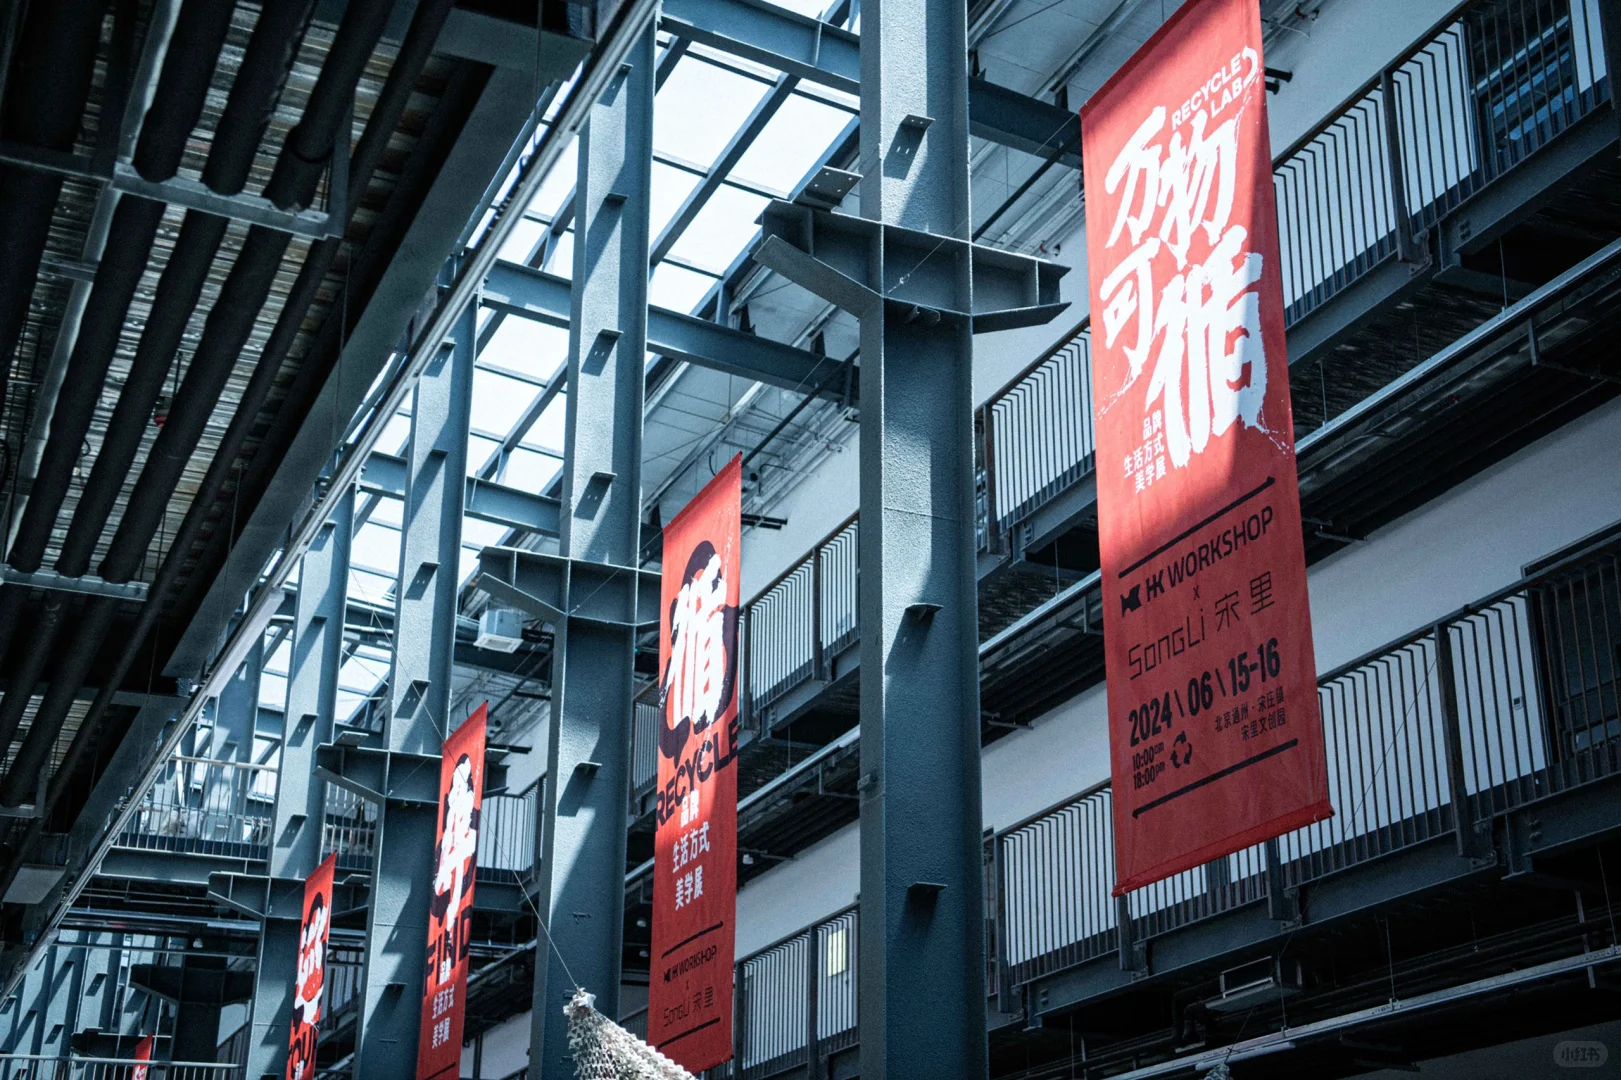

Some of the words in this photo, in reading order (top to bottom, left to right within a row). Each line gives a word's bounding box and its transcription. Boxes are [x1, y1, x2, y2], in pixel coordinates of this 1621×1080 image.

[1172, 52, 1241, 131] RECYCLE
[1210, 77, 1243, 119] LAB
[1143, 409, 1163, 440] 品牌
[1123, 432, 1165, 478] 生活方式
[1135, 455, 1166, 494] 美学展
[1167, 505, 1273, 588] WORKSHOP
[655, 715, 739, 832] RECYCLE
[681, 788, 700, 828] 品牌
[672, 821, 710, 873] 生活方式
[675, 865, 703, 911] 美学展
[680, 945, 717, 976] WORKSHOP
